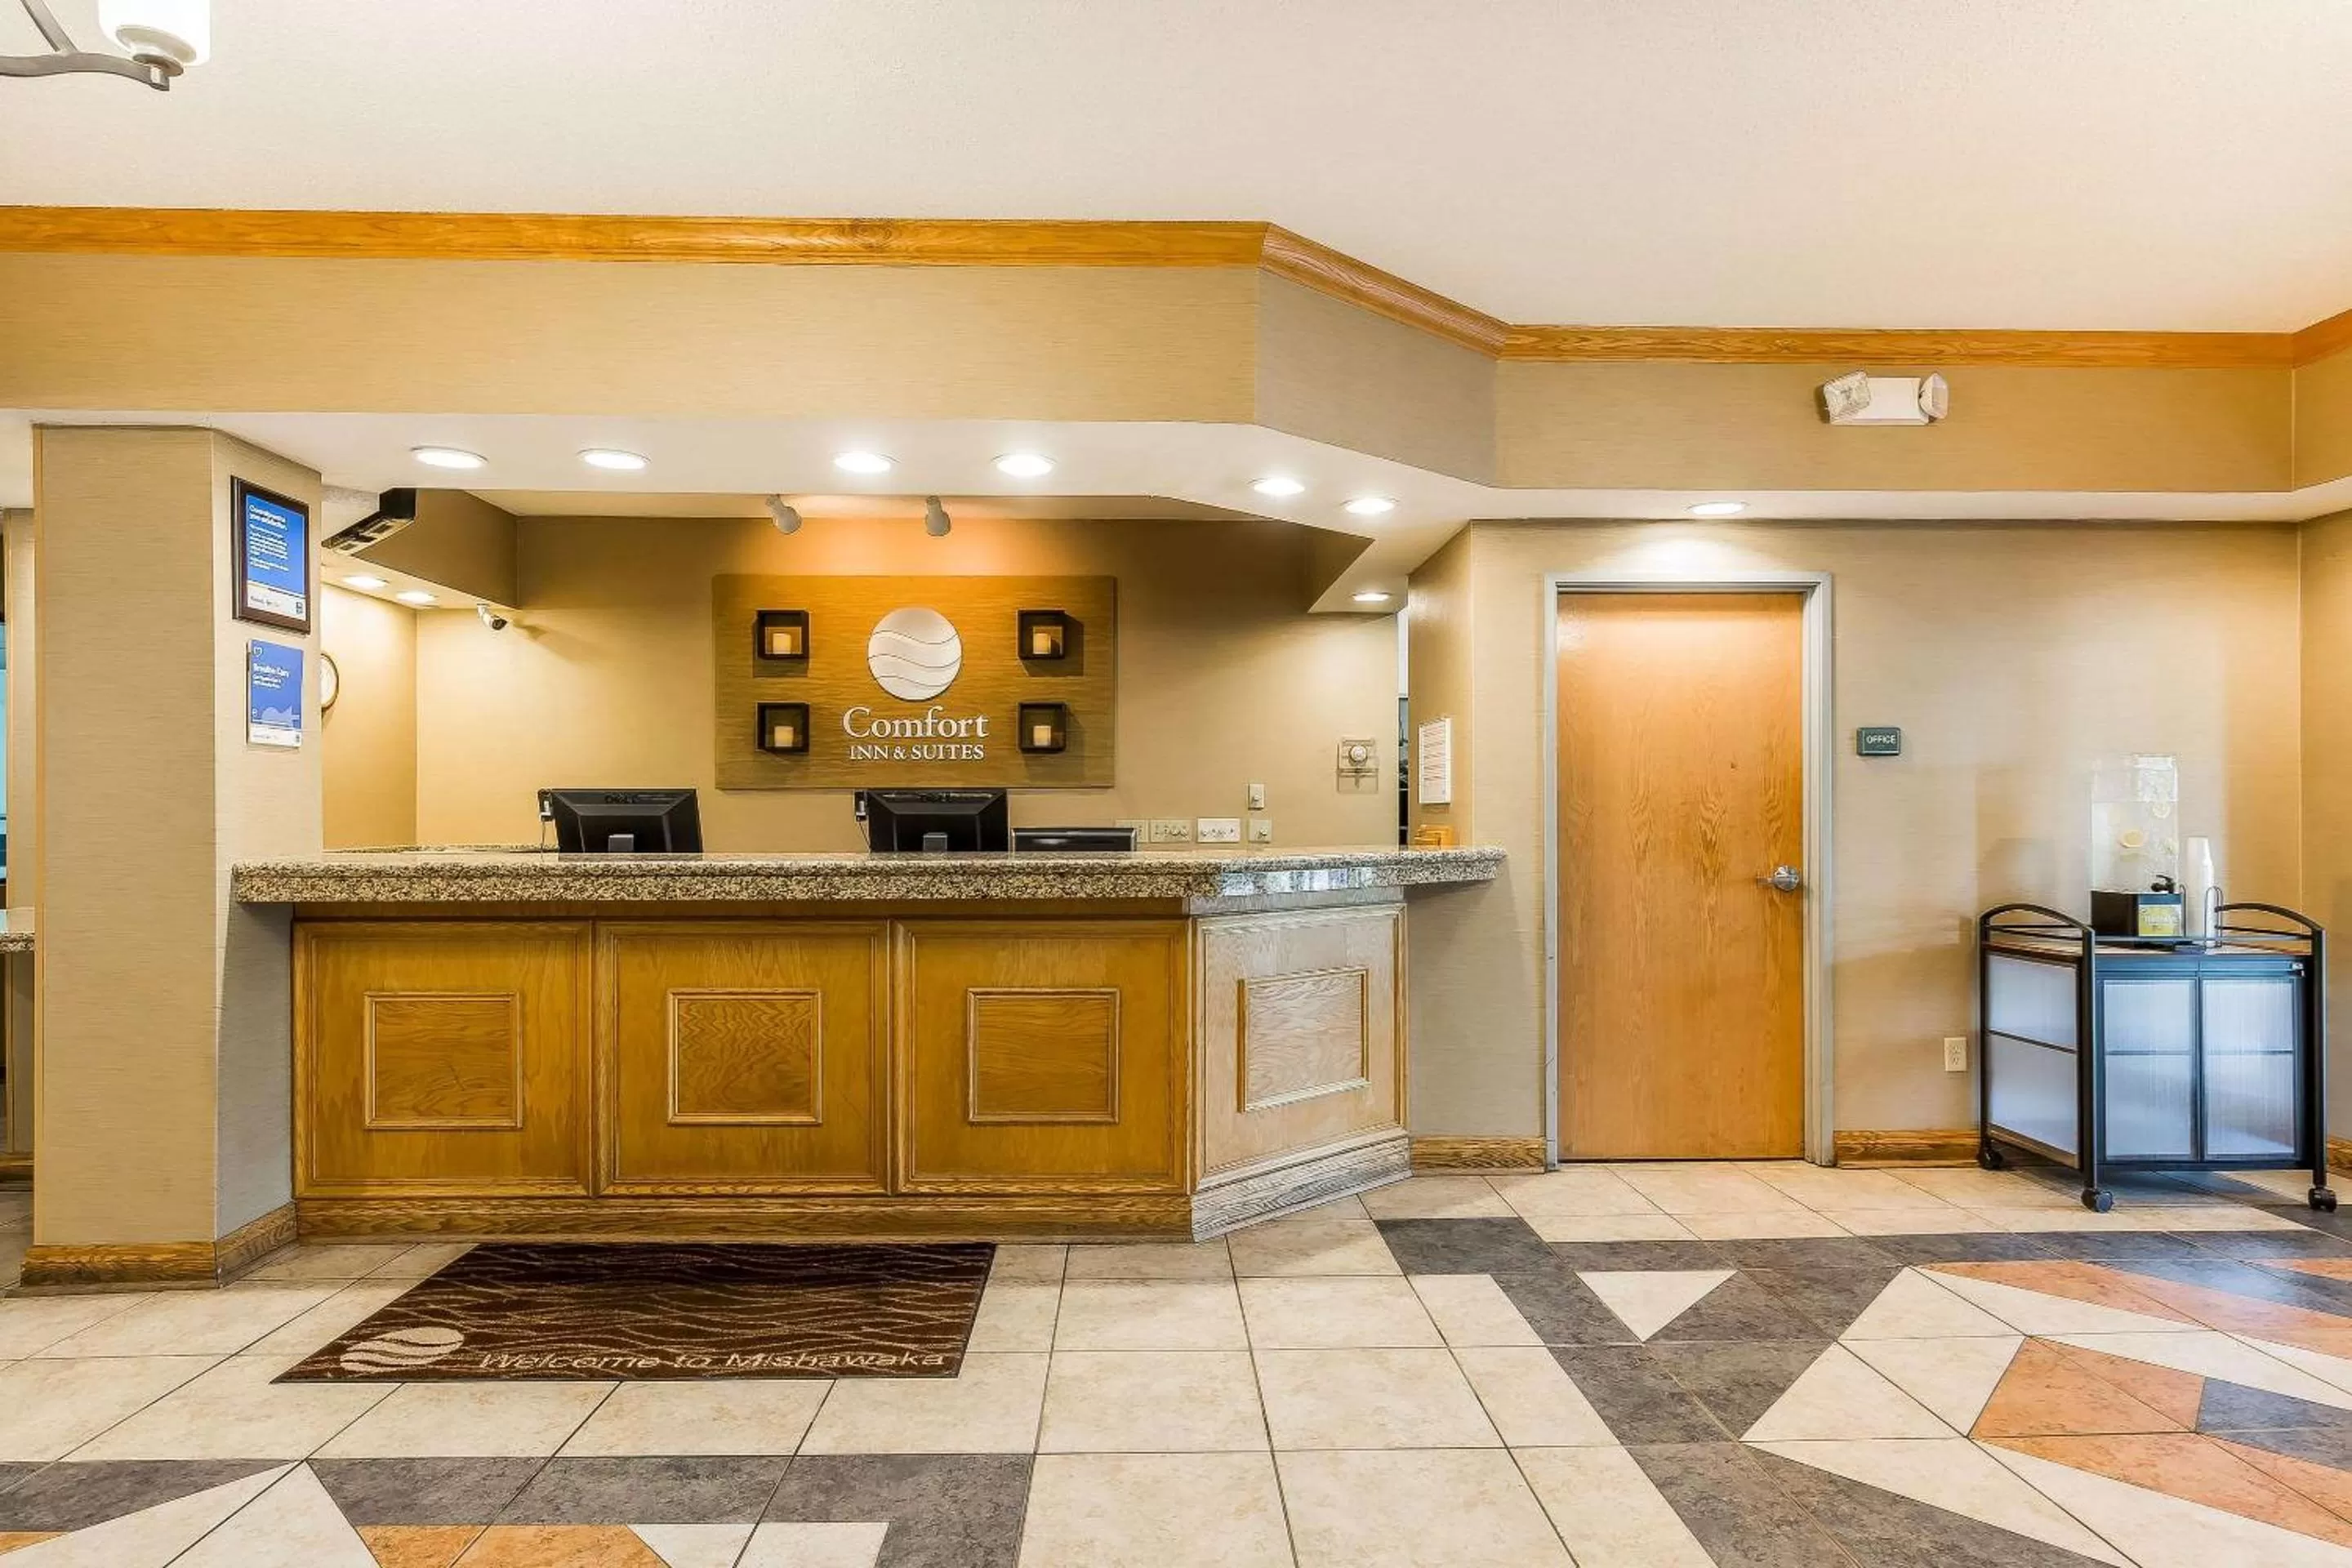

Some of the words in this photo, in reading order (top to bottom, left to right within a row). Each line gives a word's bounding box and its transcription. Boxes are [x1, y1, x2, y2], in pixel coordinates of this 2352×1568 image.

[842, 705, 991, 738] Comfort
[1866, 734, 1896, 744] OFFICE
[849, 744, 889, 760] INN
[893, 745, 906, 760] &
[911, 744, 985, 760] SUITES
[479, 1352, 660, 1369] Welcome
[674, 1352, 714, 1368] to
[724, 1352, 945, 1367] Mishawaka
